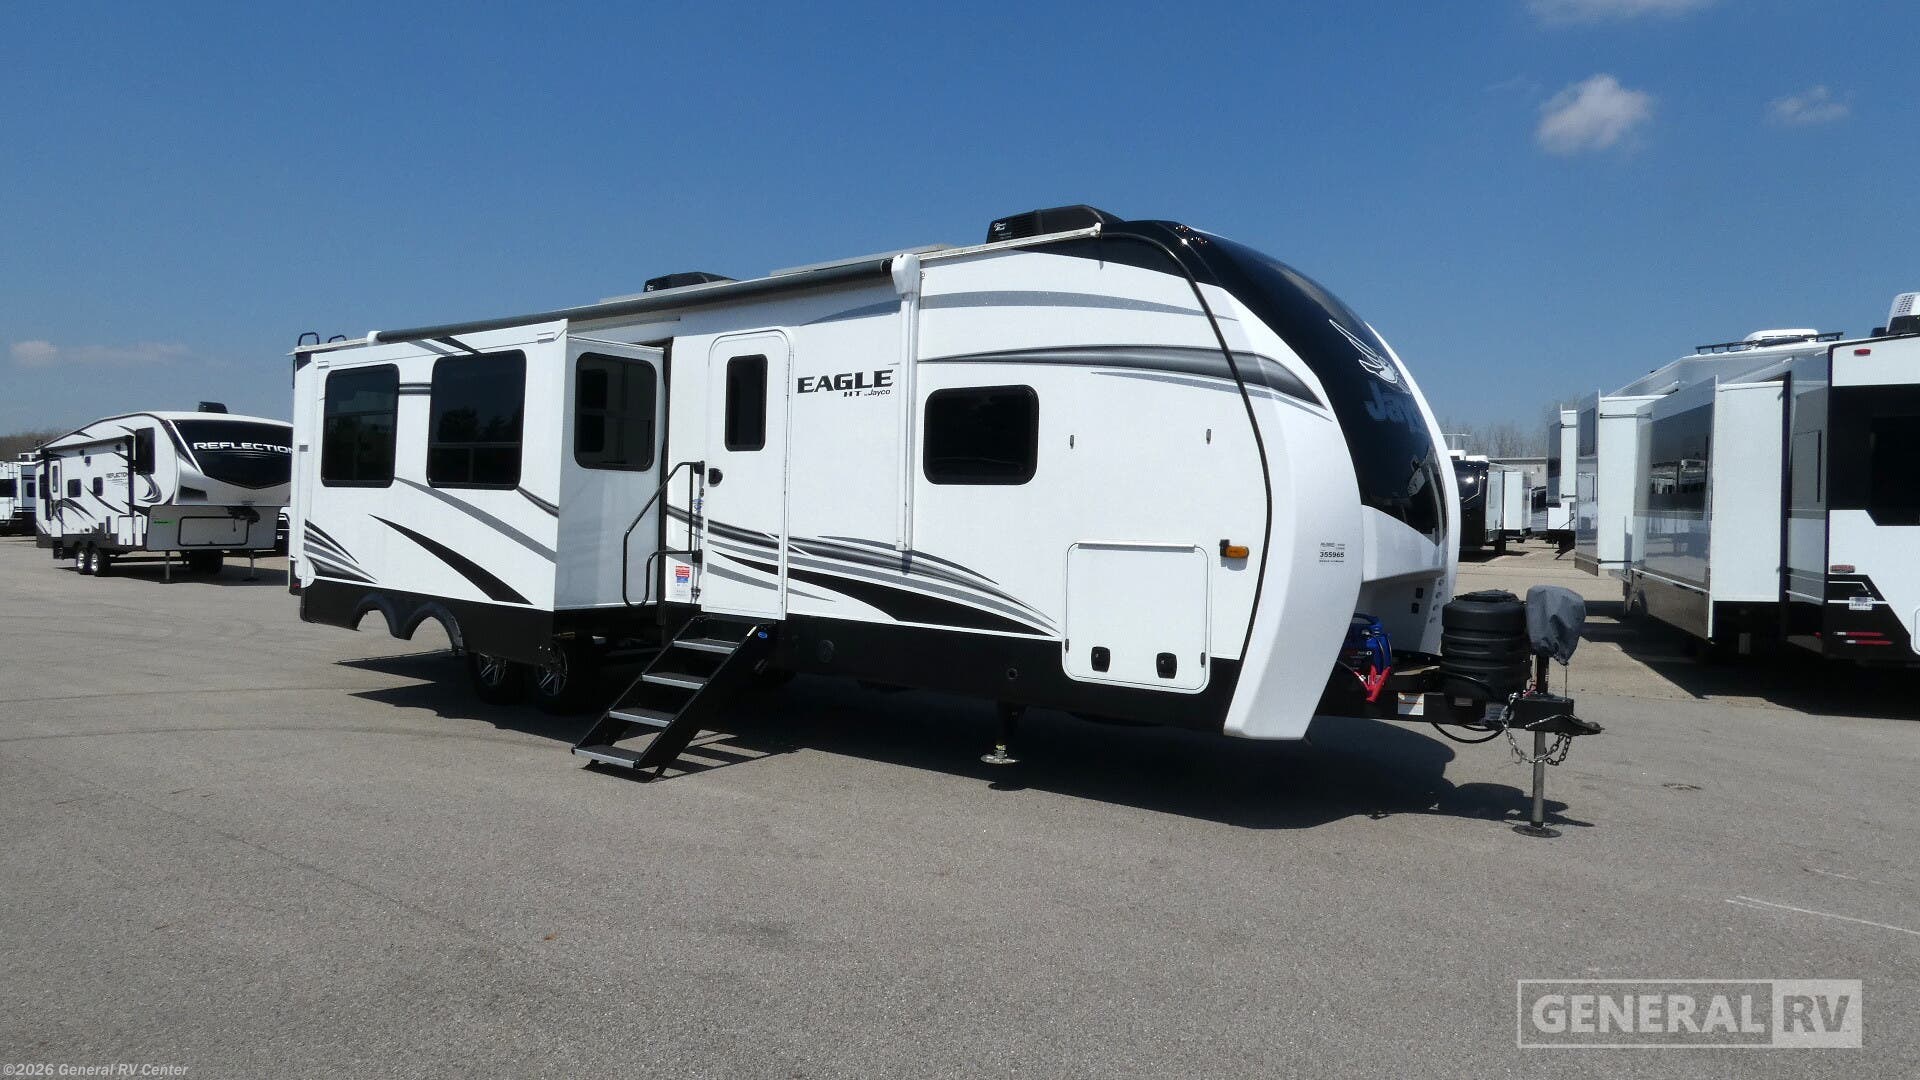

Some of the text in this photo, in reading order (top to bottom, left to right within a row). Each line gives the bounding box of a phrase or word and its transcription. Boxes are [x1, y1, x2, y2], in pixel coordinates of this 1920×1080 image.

[797, 369, 894, 394] EAGLE
[843, 388, 891, 398] HT Jayco
